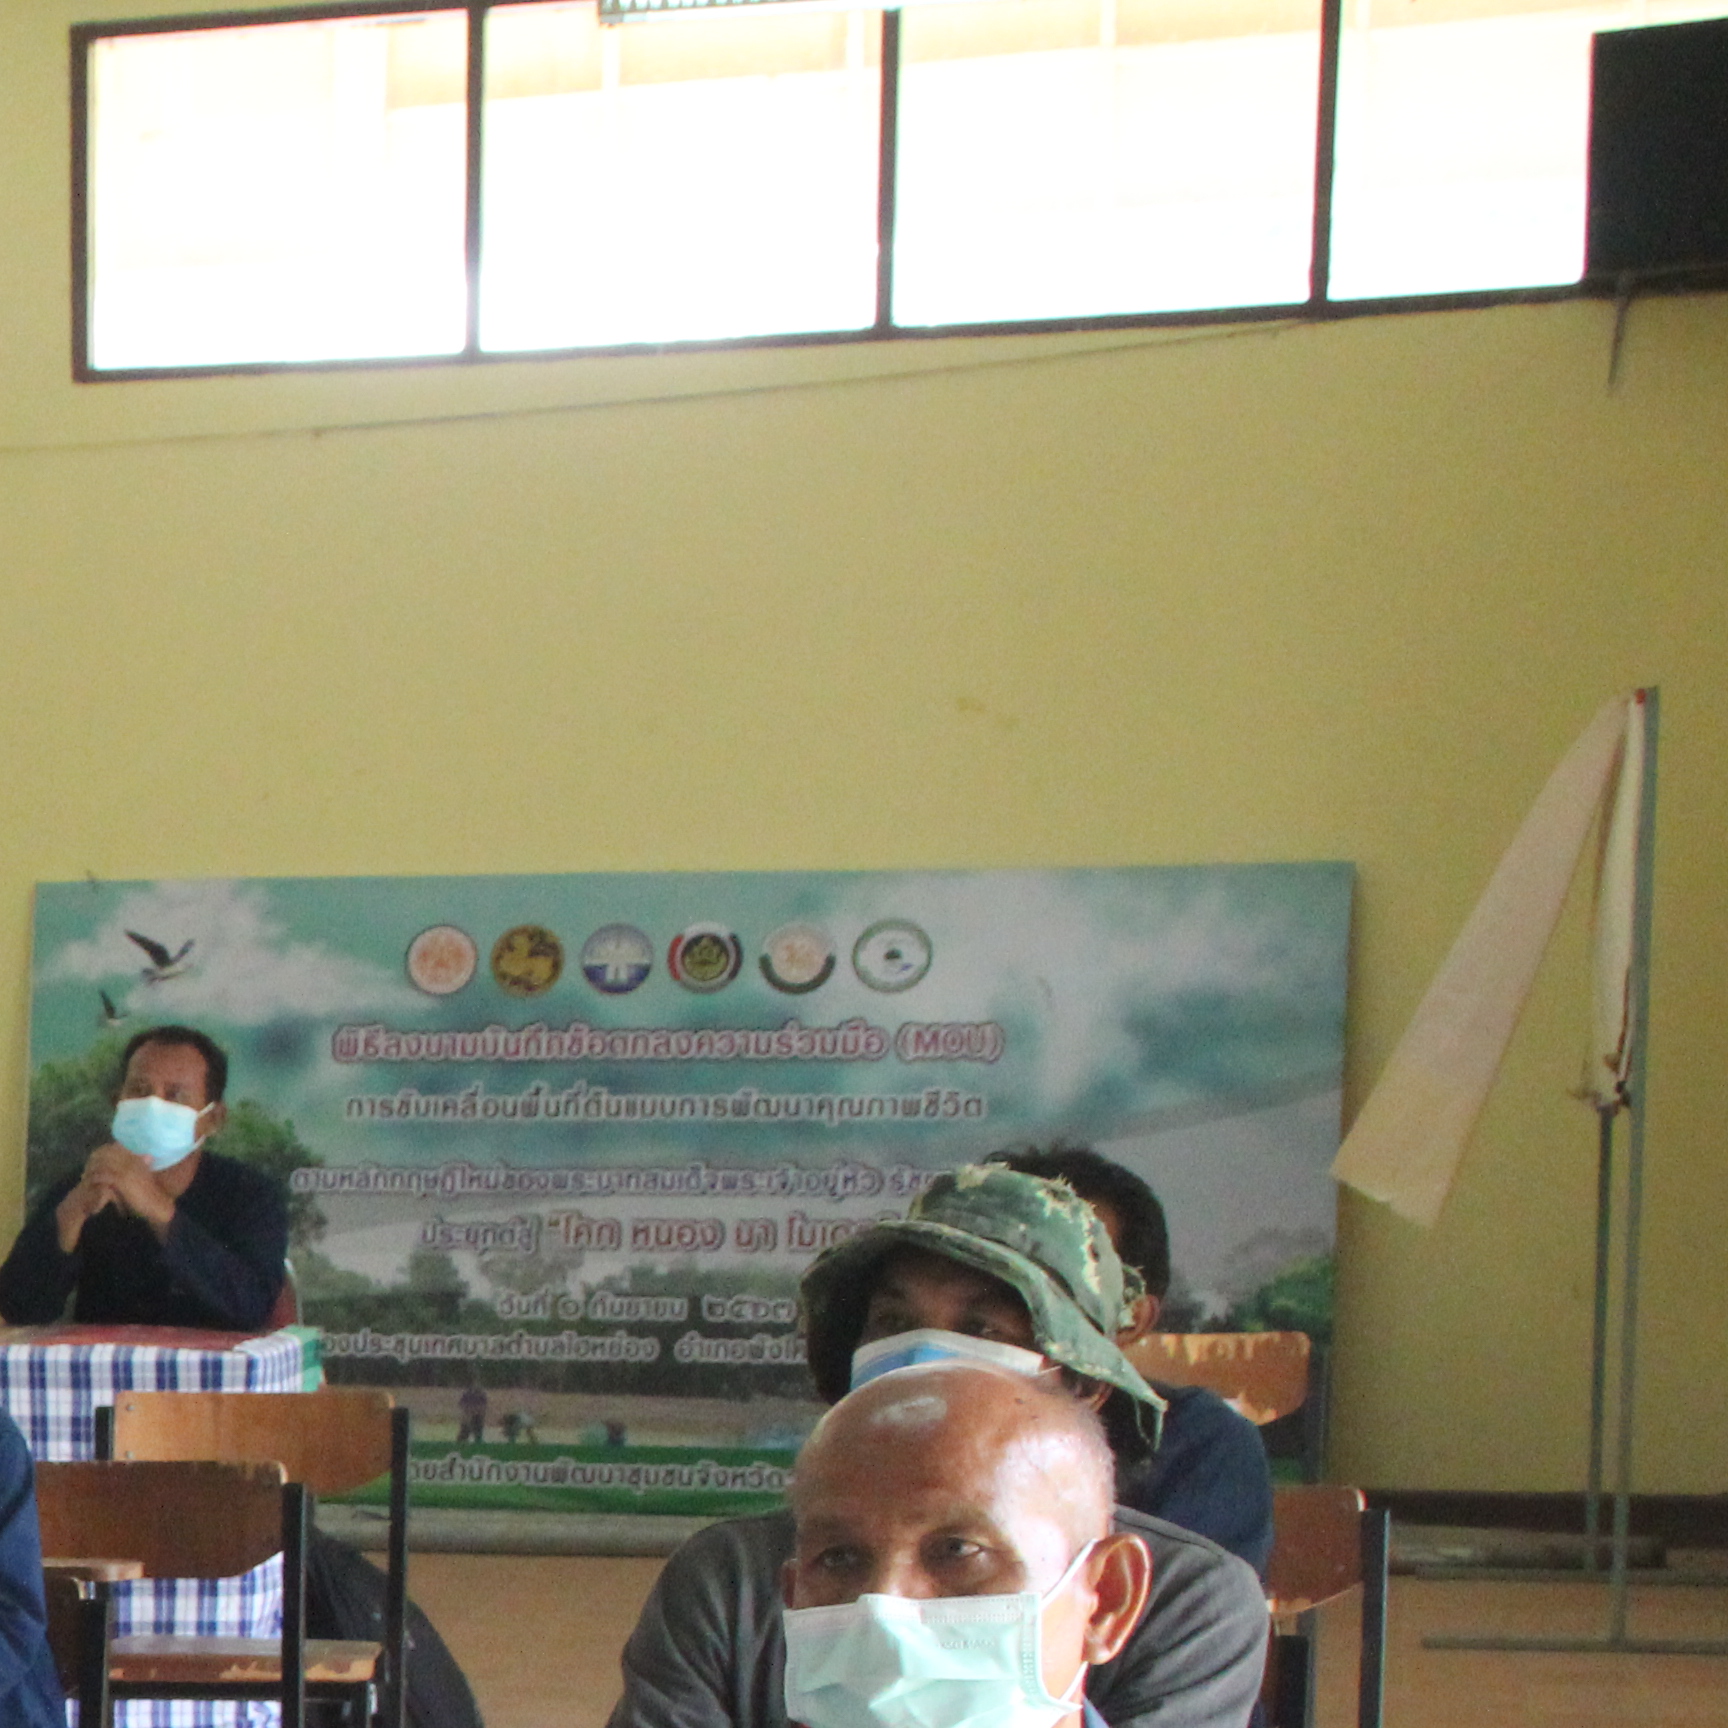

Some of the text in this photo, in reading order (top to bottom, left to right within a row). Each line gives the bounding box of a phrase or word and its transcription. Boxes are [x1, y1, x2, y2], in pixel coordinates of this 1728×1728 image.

[897, 1025, 999, 1060] (MOU)
[631, 1220, 720, 1249] หนอง
[734, 1220, 775, 1249] นา
